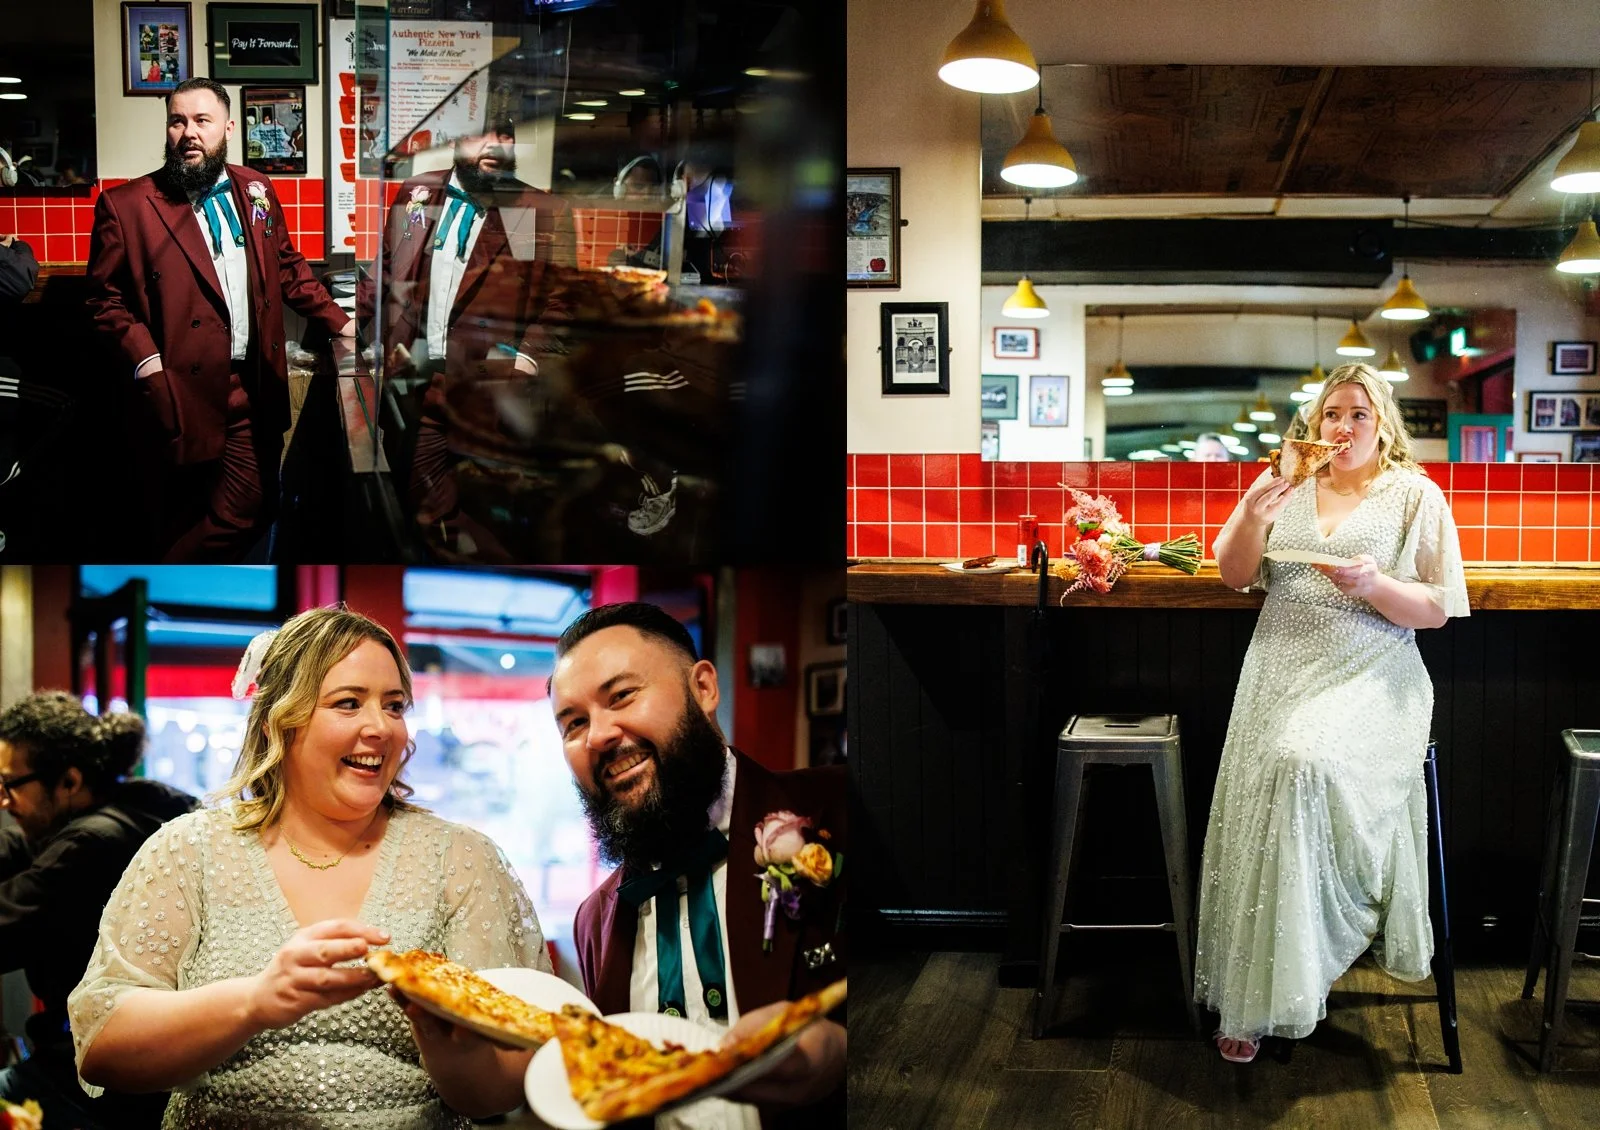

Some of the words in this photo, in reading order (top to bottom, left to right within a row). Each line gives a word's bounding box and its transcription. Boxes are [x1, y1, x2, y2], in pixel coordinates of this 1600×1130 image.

[392, 29, 434, 38] Authentic
[438, 30, 456, 38] New
[459, 30, 481, 39] York
[231, 38, 247, 50] Pay
[257, 38, 298, 48] Forward...
[418, 38, 455, 47] Pizzeria
[420, 49, 437, 57] Make
